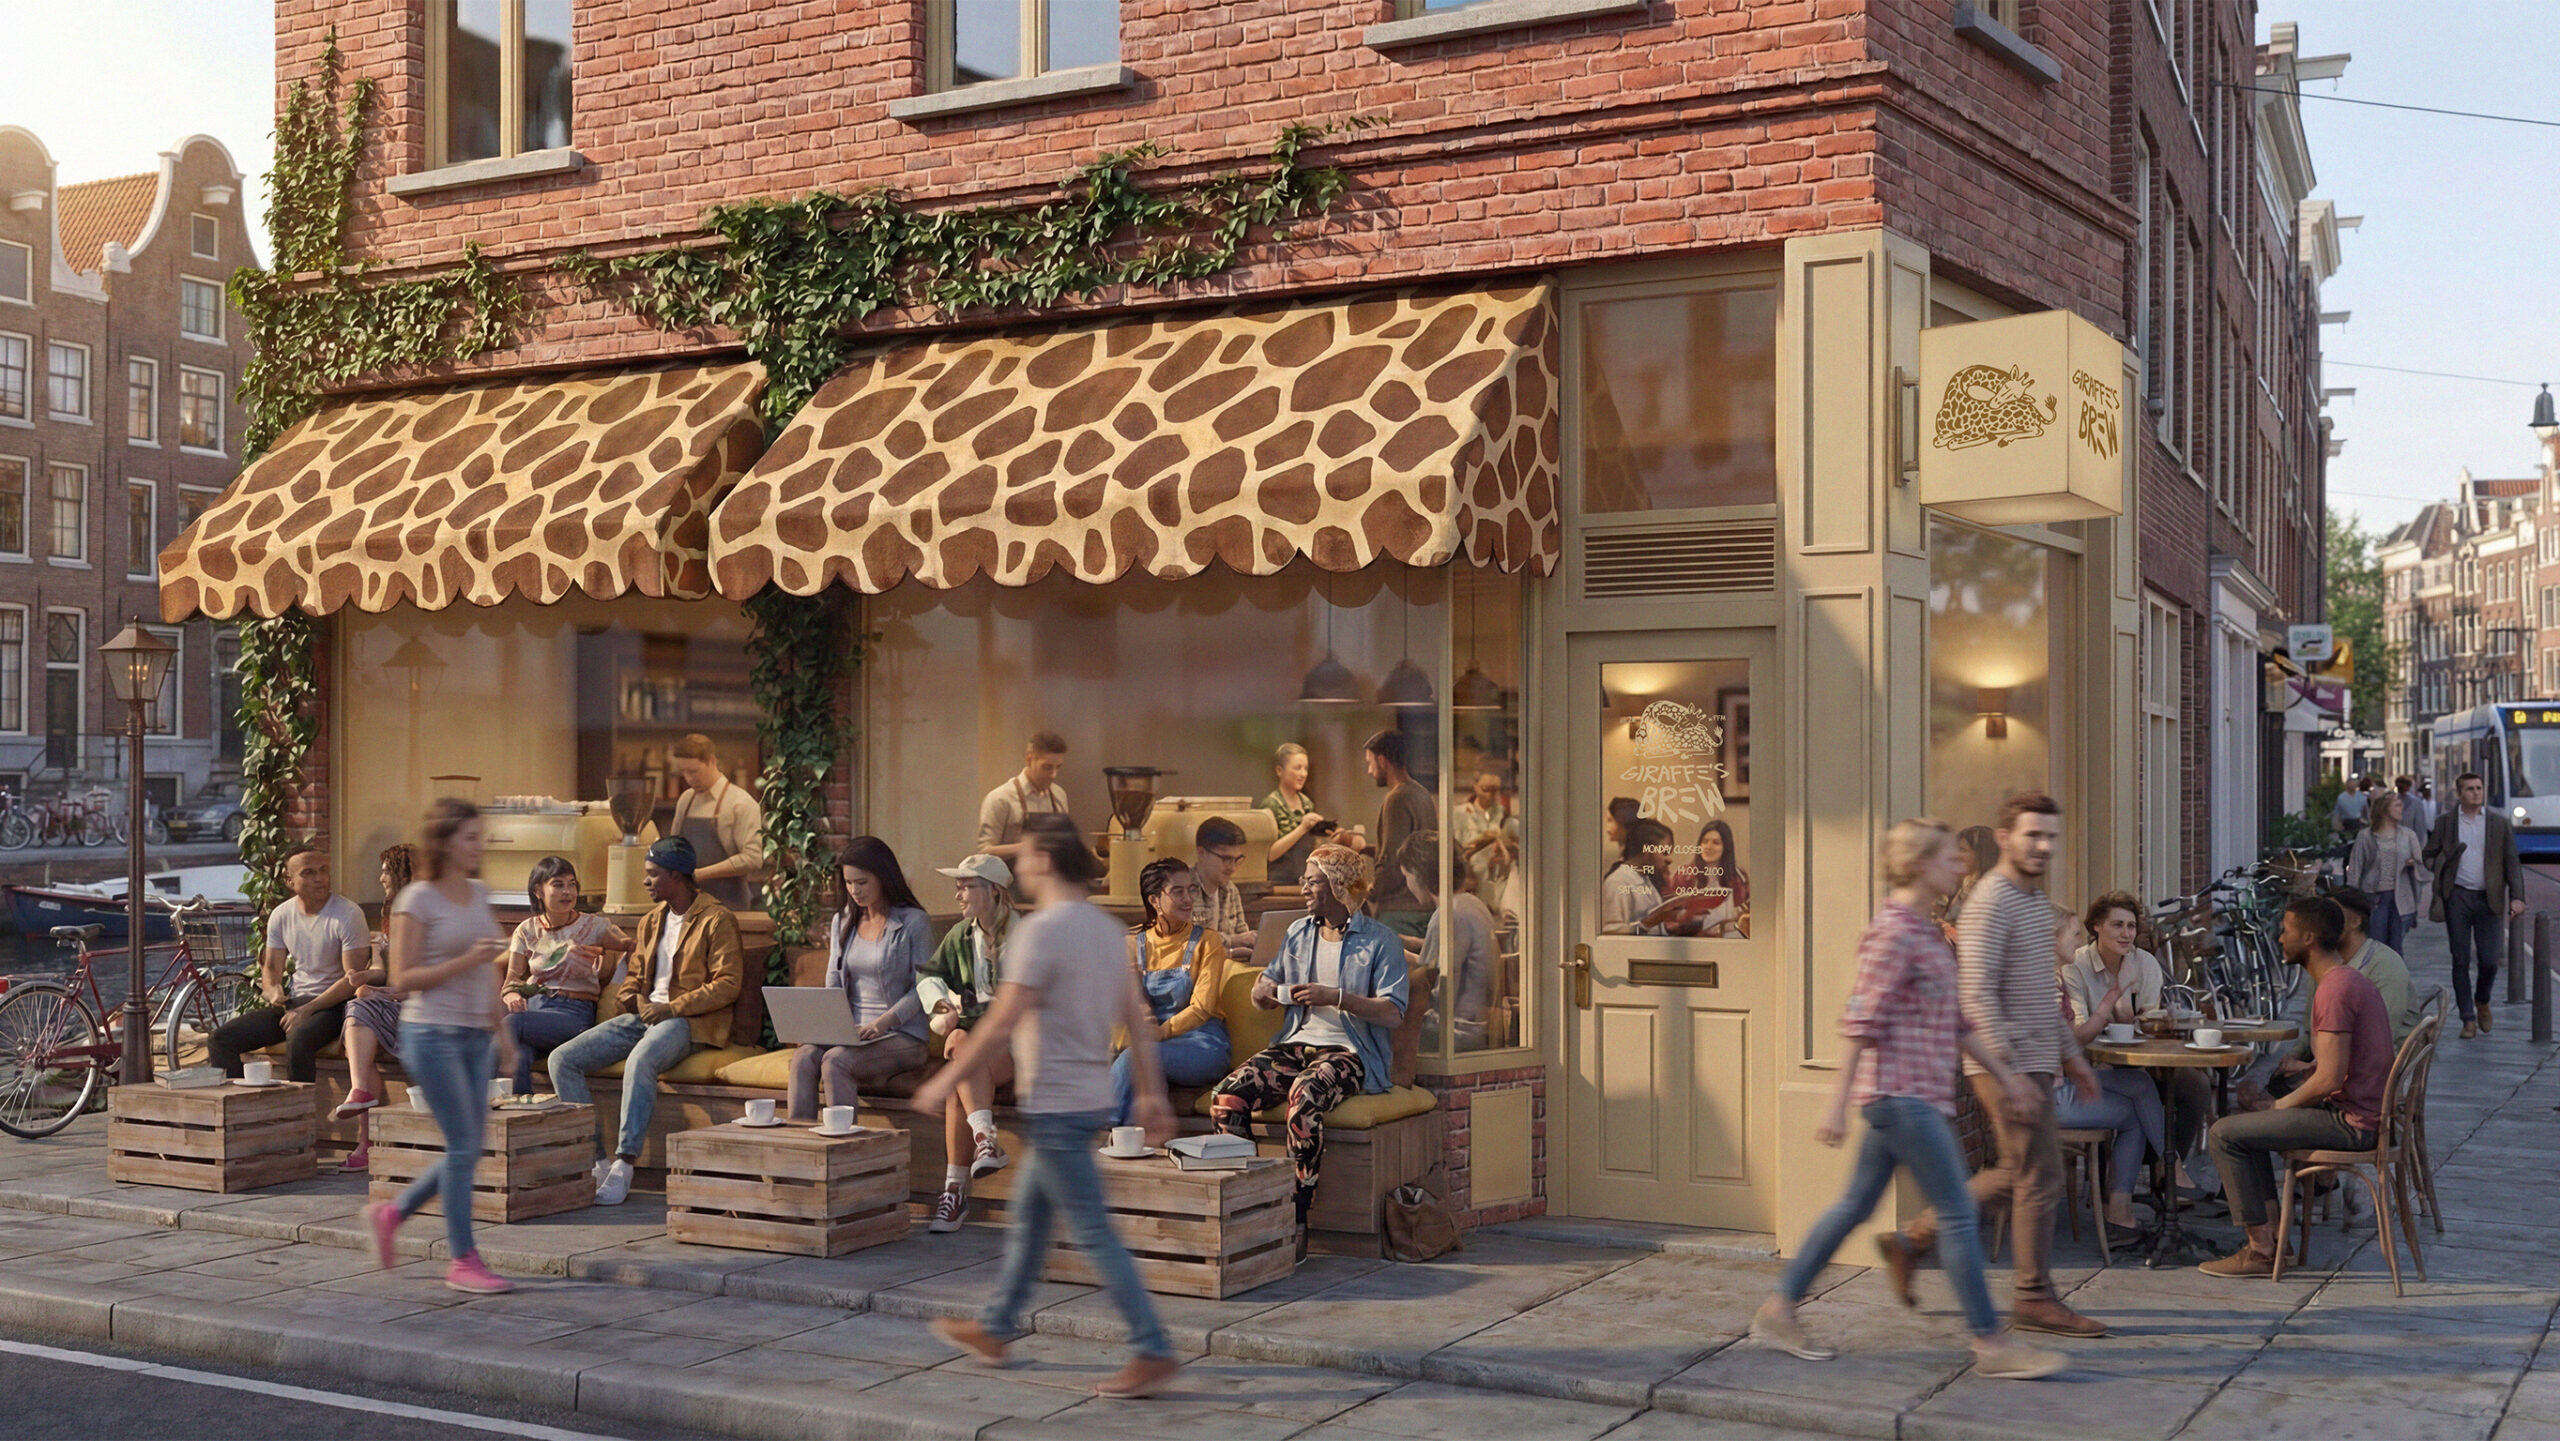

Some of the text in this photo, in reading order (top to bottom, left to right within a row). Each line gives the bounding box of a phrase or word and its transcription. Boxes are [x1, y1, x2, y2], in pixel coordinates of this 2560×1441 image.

[2072, 368, 2120, 410] GIRAFFE'S
[2078, 400, 2118, 460] BREW
[1619, 763, 1730, 784] GIRAFFE'S
[1636, 782, 1726, 823] BREW
[1642, 844, 1704, 855] MONDAY CLOSED
